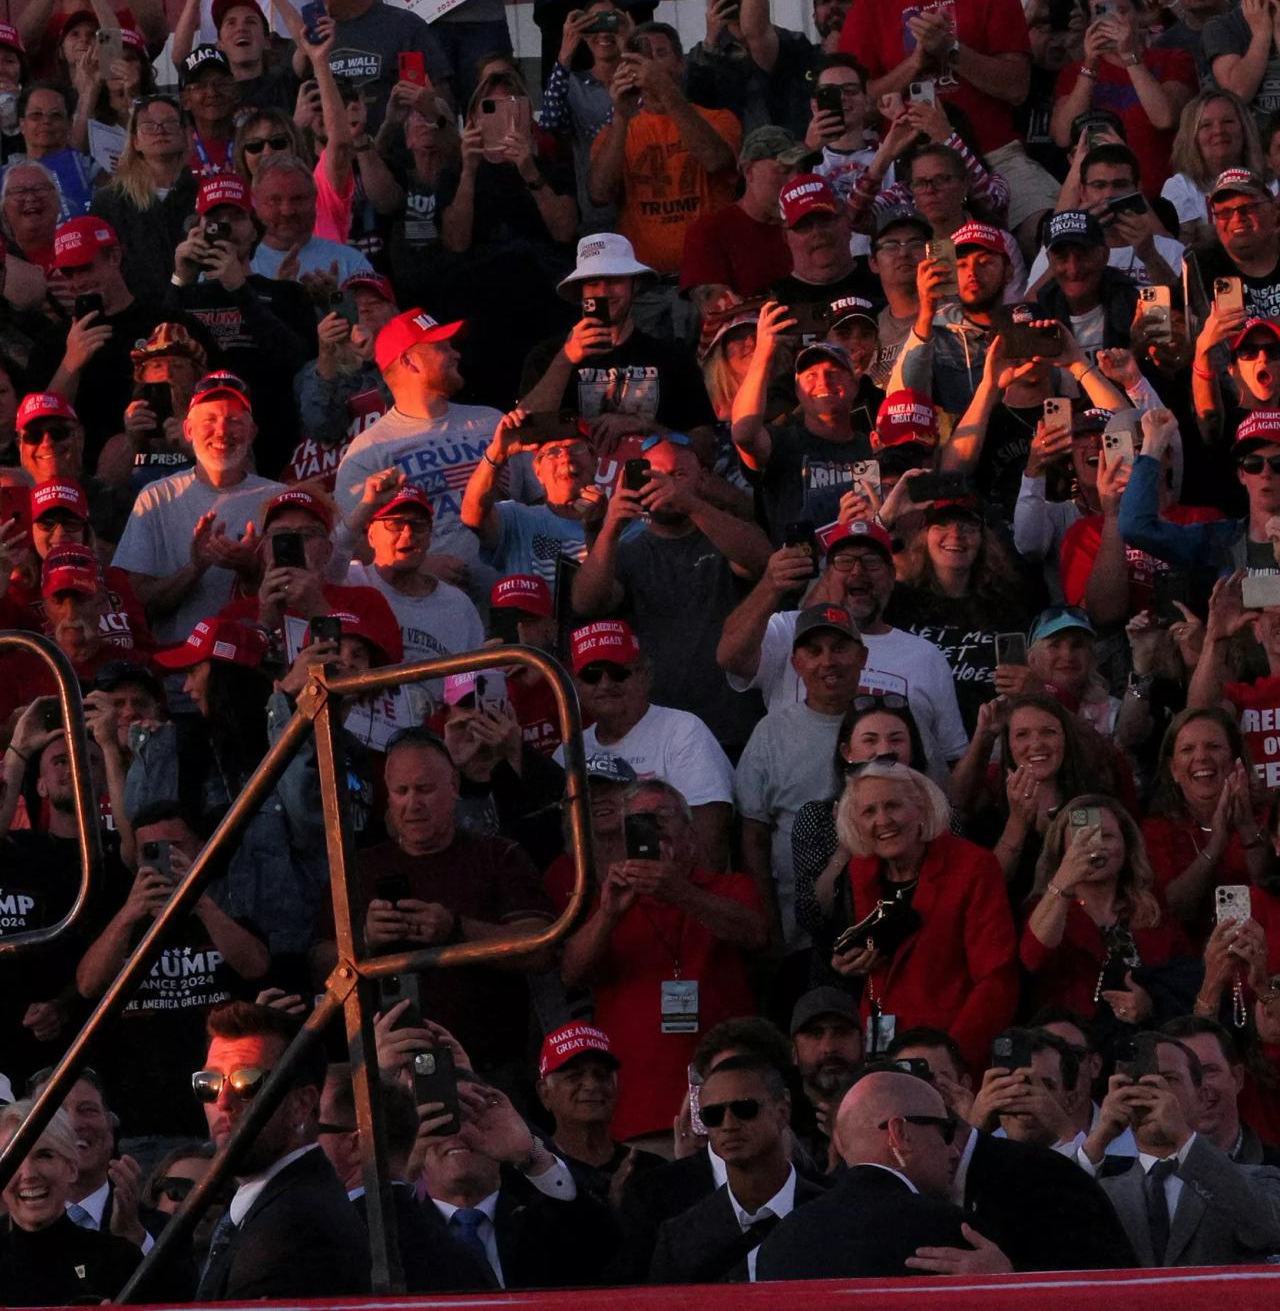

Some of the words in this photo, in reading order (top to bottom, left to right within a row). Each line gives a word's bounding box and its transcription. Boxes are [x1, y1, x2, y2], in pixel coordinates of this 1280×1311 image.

[923, 0, 955, 10] nation
[347, 56, 378, 68] WALL
[784, 182, 824, 203] TRUMP
[640, 197, 701, 216] TRUMP
[966, 224, 1000, 237] AMERICA
[972, 232, 996, 242] AGAIN
[830, 296, 873, 312] TRUMP
[578, 365, 659, 382] WANTED
[887, 404, 906, 415] MAKE
[905, 403, 933, 418] AMERICA
[891, 414, 911, 425] GREAT
[911, 414, 931, 426] AGAIN
[400, 439, 494, 477] TRUM
[51, 485, 79, 496] AMERICA
[277, 492, 312, 503] Trump
[497, 579, 539, 593] TRUMP
[573, 629, 591, 642] MAKE
[591, 622, 624, 634] AMERICA
[962, 631, 994, 643] ME
[578, 638, 597, 654] GREAT
[598, 636, 623, 646] AGAIN
[938, 644, 978, 662] ET
[952, 662, 997, 683] HOES
[139, 977, 177, 991] ANCE
[180, 973, 215, 988] 2024
[142, 997, 180, 1010] AMERICA
[181, 993, 207, 1007] GREAT
[208, 990, 231, 1004] AGA
[549, 1028, 575, 1046] MAKE
[574, 1026, 610, 1043] AMERICA
[556, 1038, 586, 1056] GREAT
[585, 1038, 610, 1051] AGAIN
